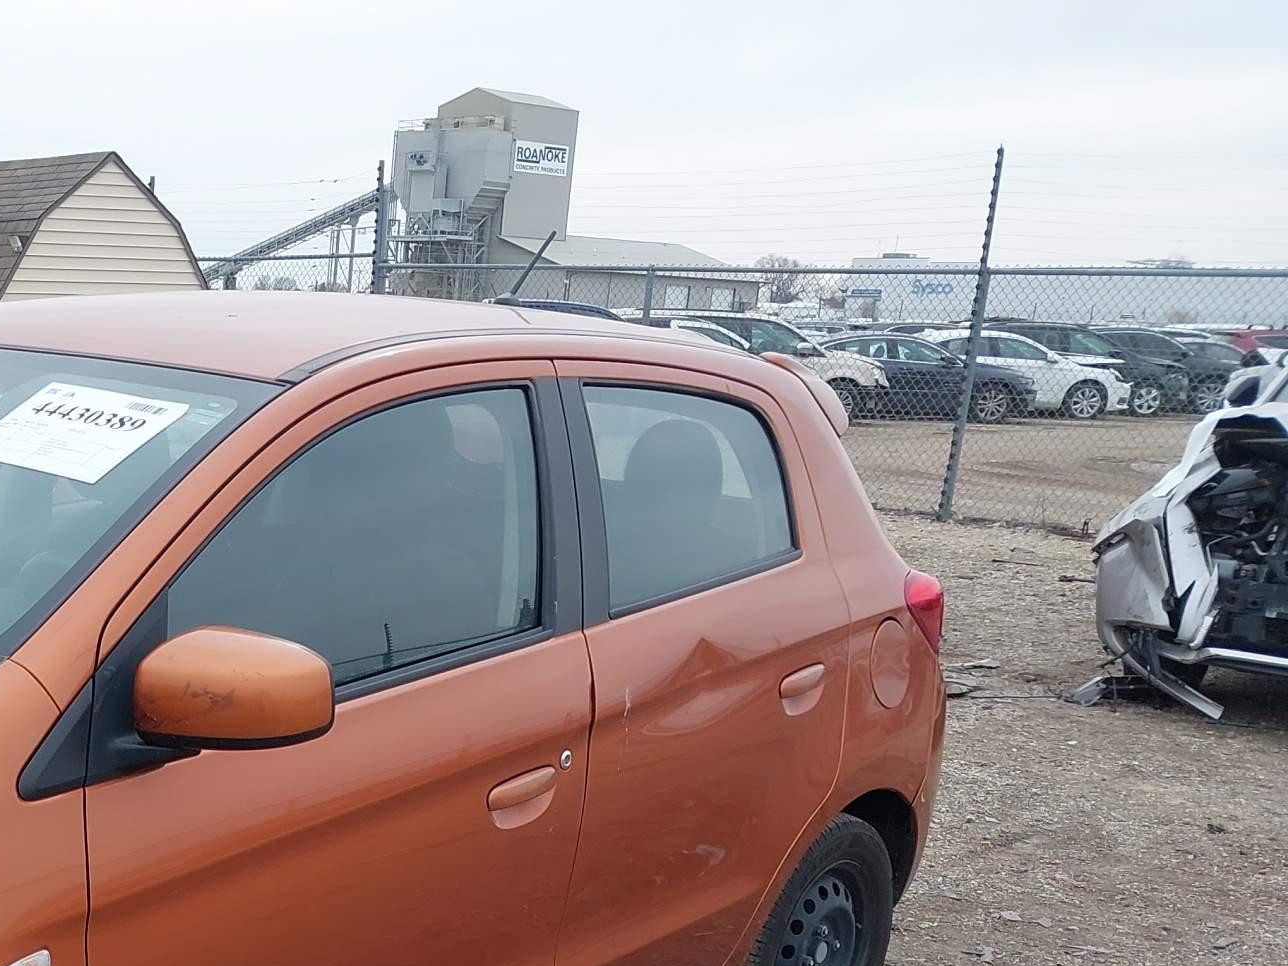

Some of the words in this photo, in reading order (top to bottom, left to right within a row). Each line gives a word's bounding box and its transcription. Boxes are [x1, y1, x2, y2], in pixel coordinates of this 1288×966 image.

[516, 146, 567, 163] ROANOKE
[912, 278, 953, 296] Sysco
[31, 401, 147, 432] 44430389
